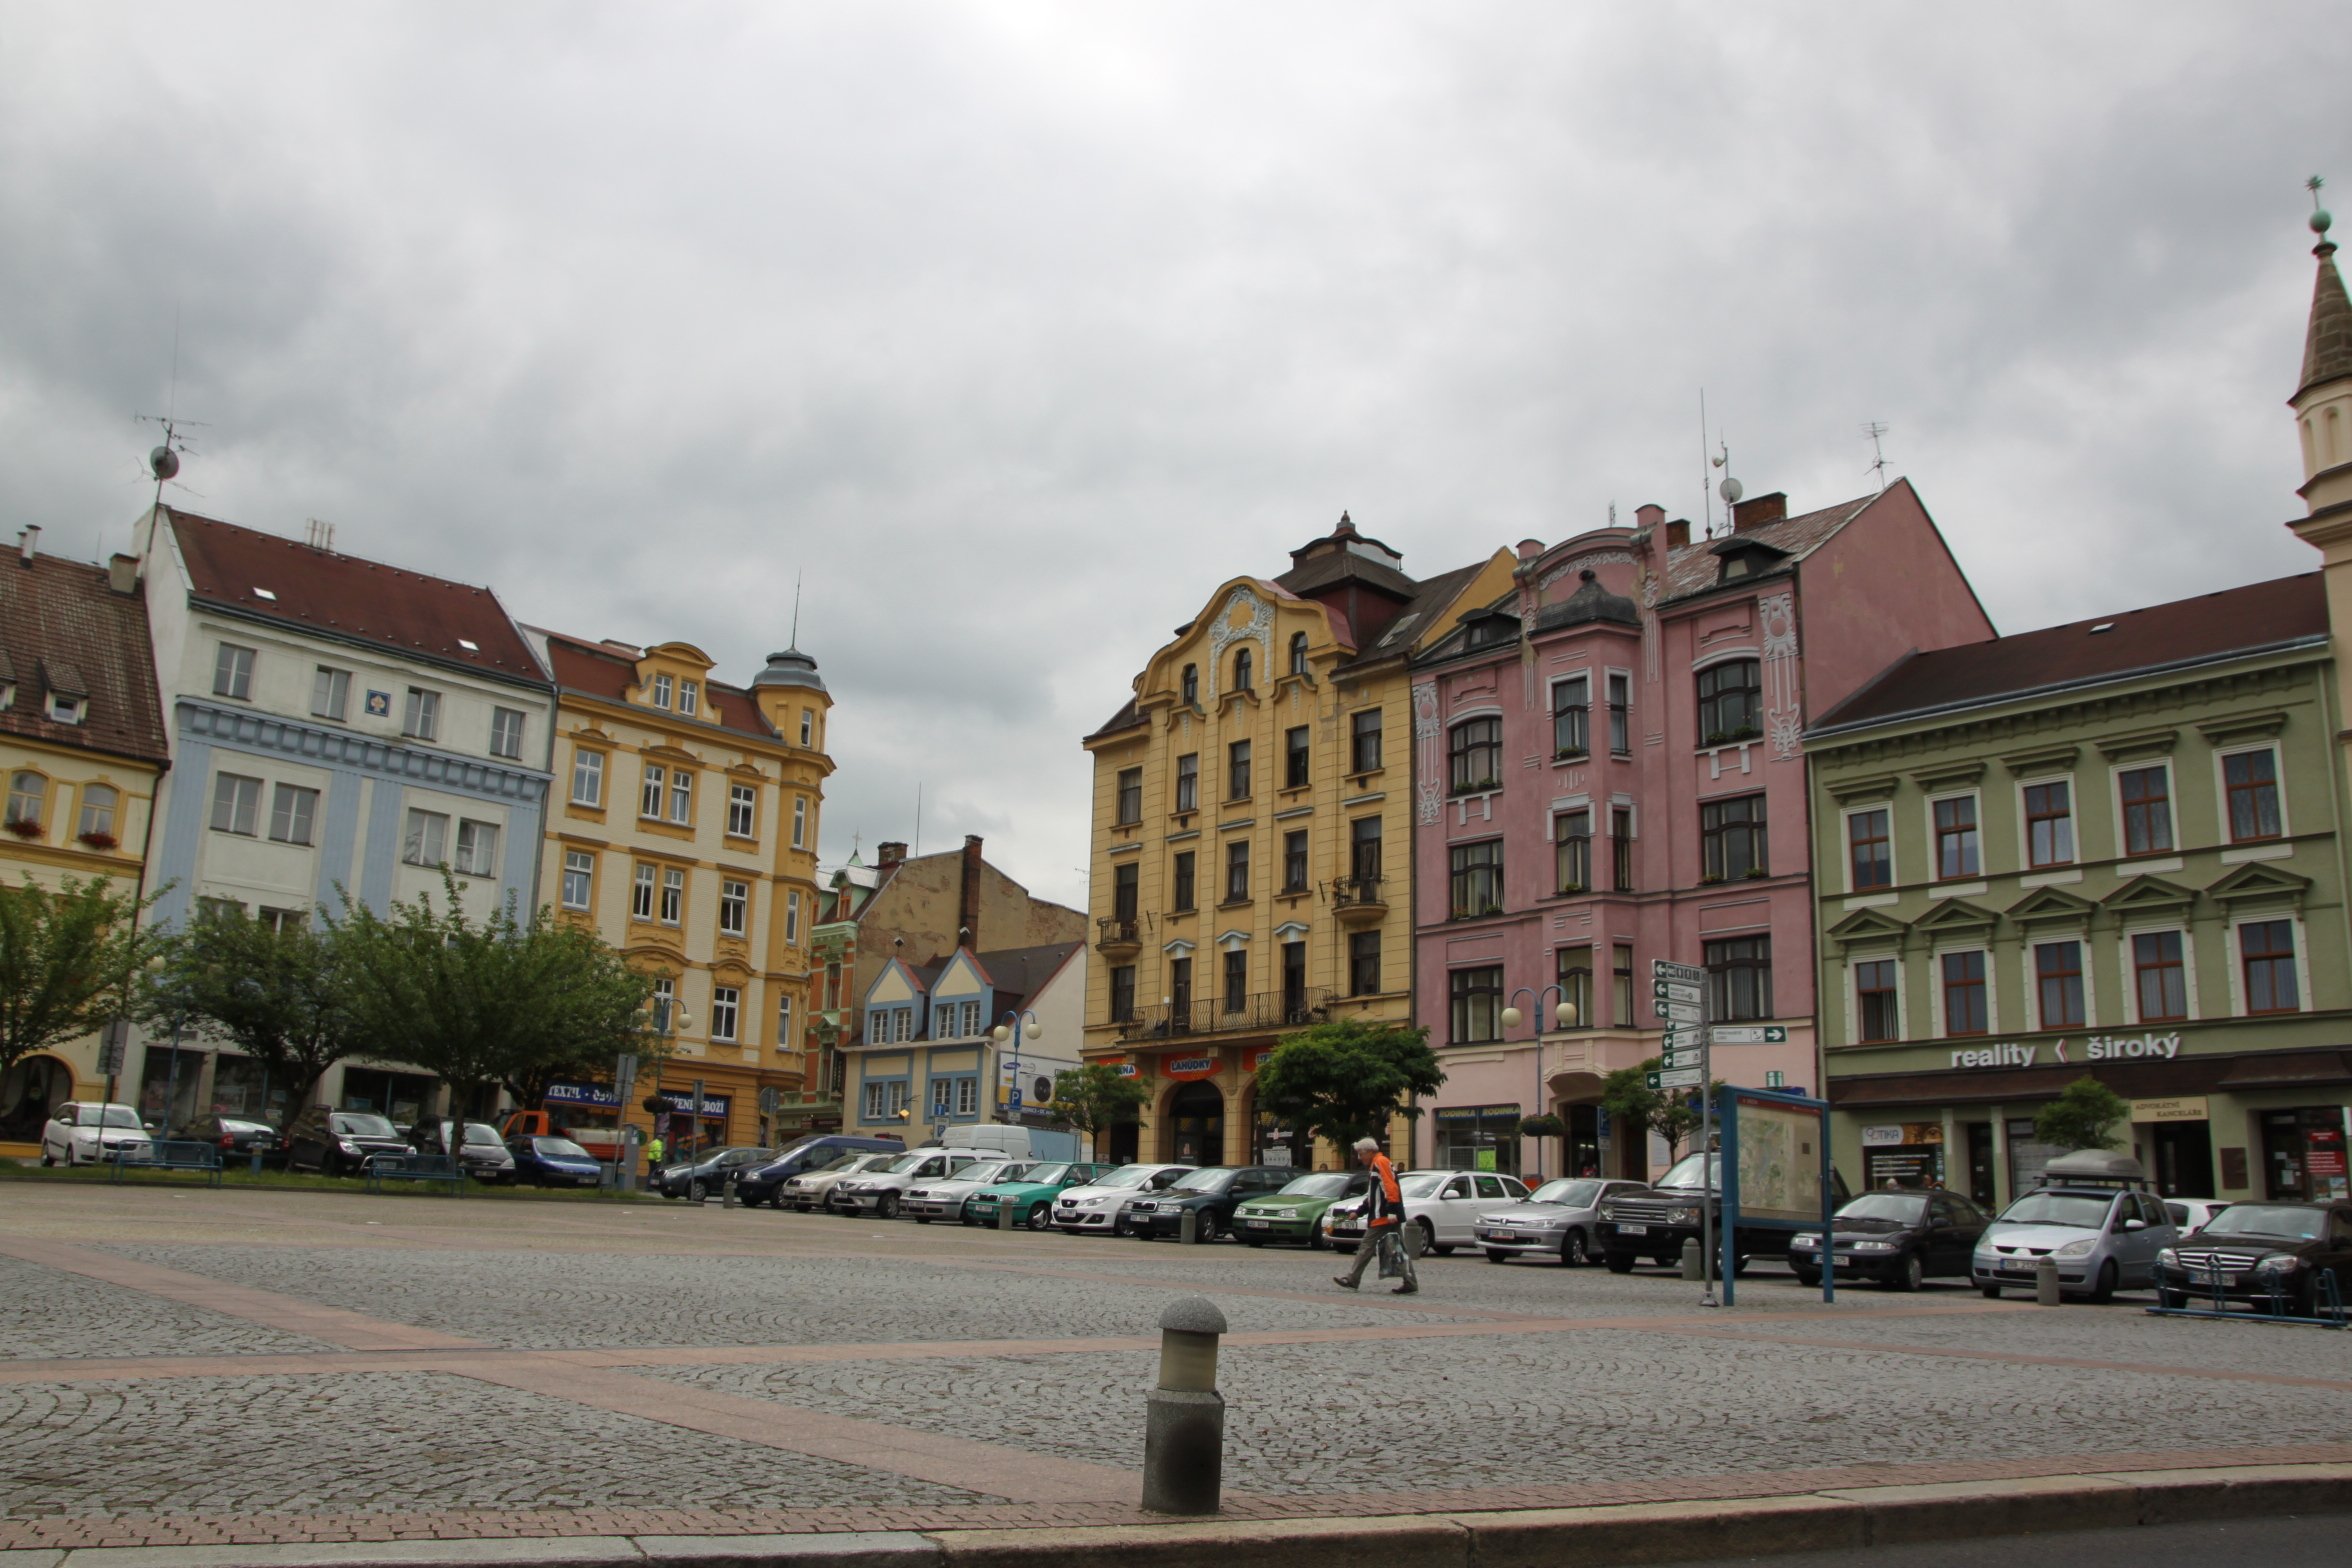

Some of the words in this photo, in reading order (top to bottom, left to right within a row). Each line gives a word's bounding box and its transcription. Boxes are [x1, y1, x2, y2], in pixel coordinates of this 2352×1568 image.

[1951, 1043, 2036, 1068] reality
[2087, 1031, 2181, 1059] široký
[1011, 1091, 1019, 1104] P
[701, 1099, 724, 1114] BOŽÍ
